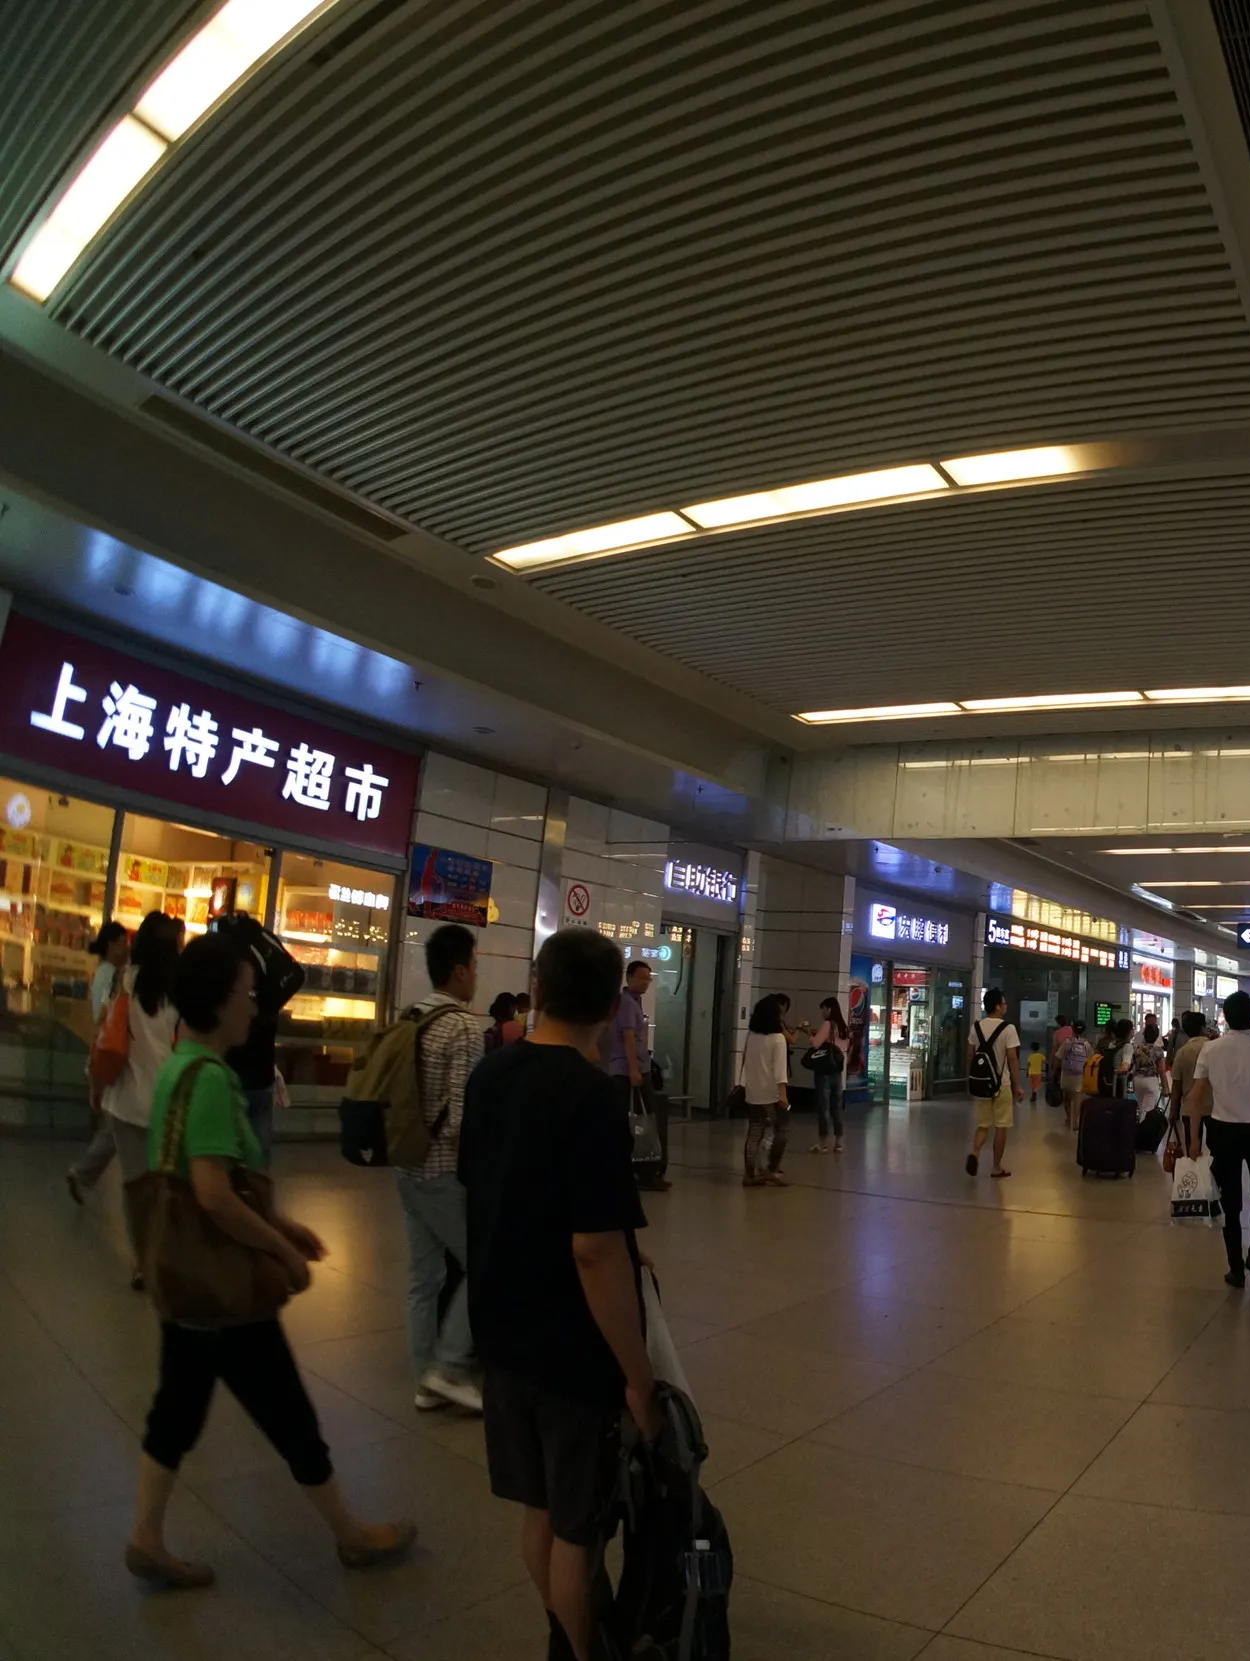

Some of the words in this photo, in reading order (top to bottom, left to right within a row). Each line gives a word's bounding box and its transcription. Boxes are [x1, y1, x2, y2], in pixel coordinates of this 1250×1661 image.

[29, 661, 391, 822] 上海特产超市
[664, 859, 739, 903] 自助银行
[988, 919, 997, 943] 5
